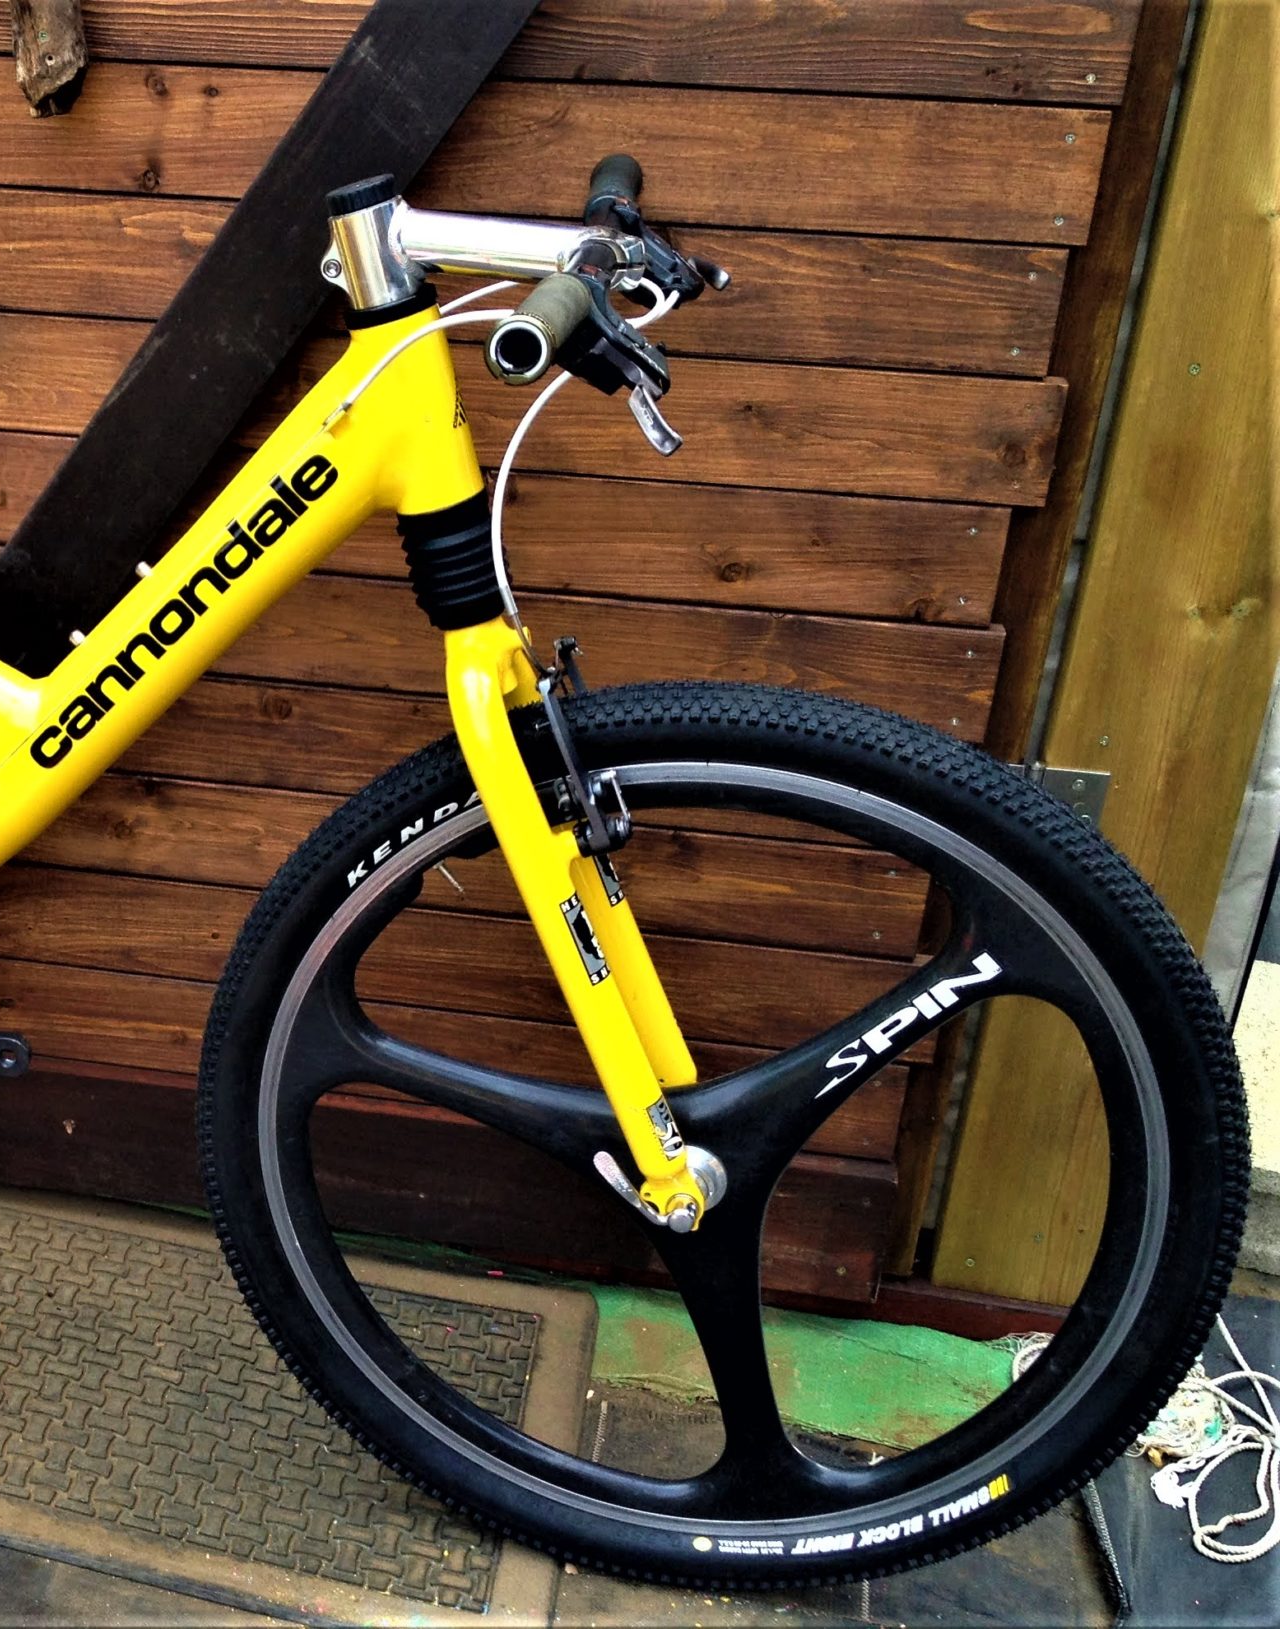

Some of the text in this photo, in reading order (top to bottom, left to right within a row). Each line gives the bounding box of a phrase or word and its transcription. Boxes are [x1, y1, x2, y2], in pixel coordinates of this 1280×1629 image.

[30, 454, 338, 768] cannondale
[814, 952, 1003, 1099] SPIN
[857, 1513, 924, 1549] BLOCK
[928, 1487, 991, 1525] SMALL
